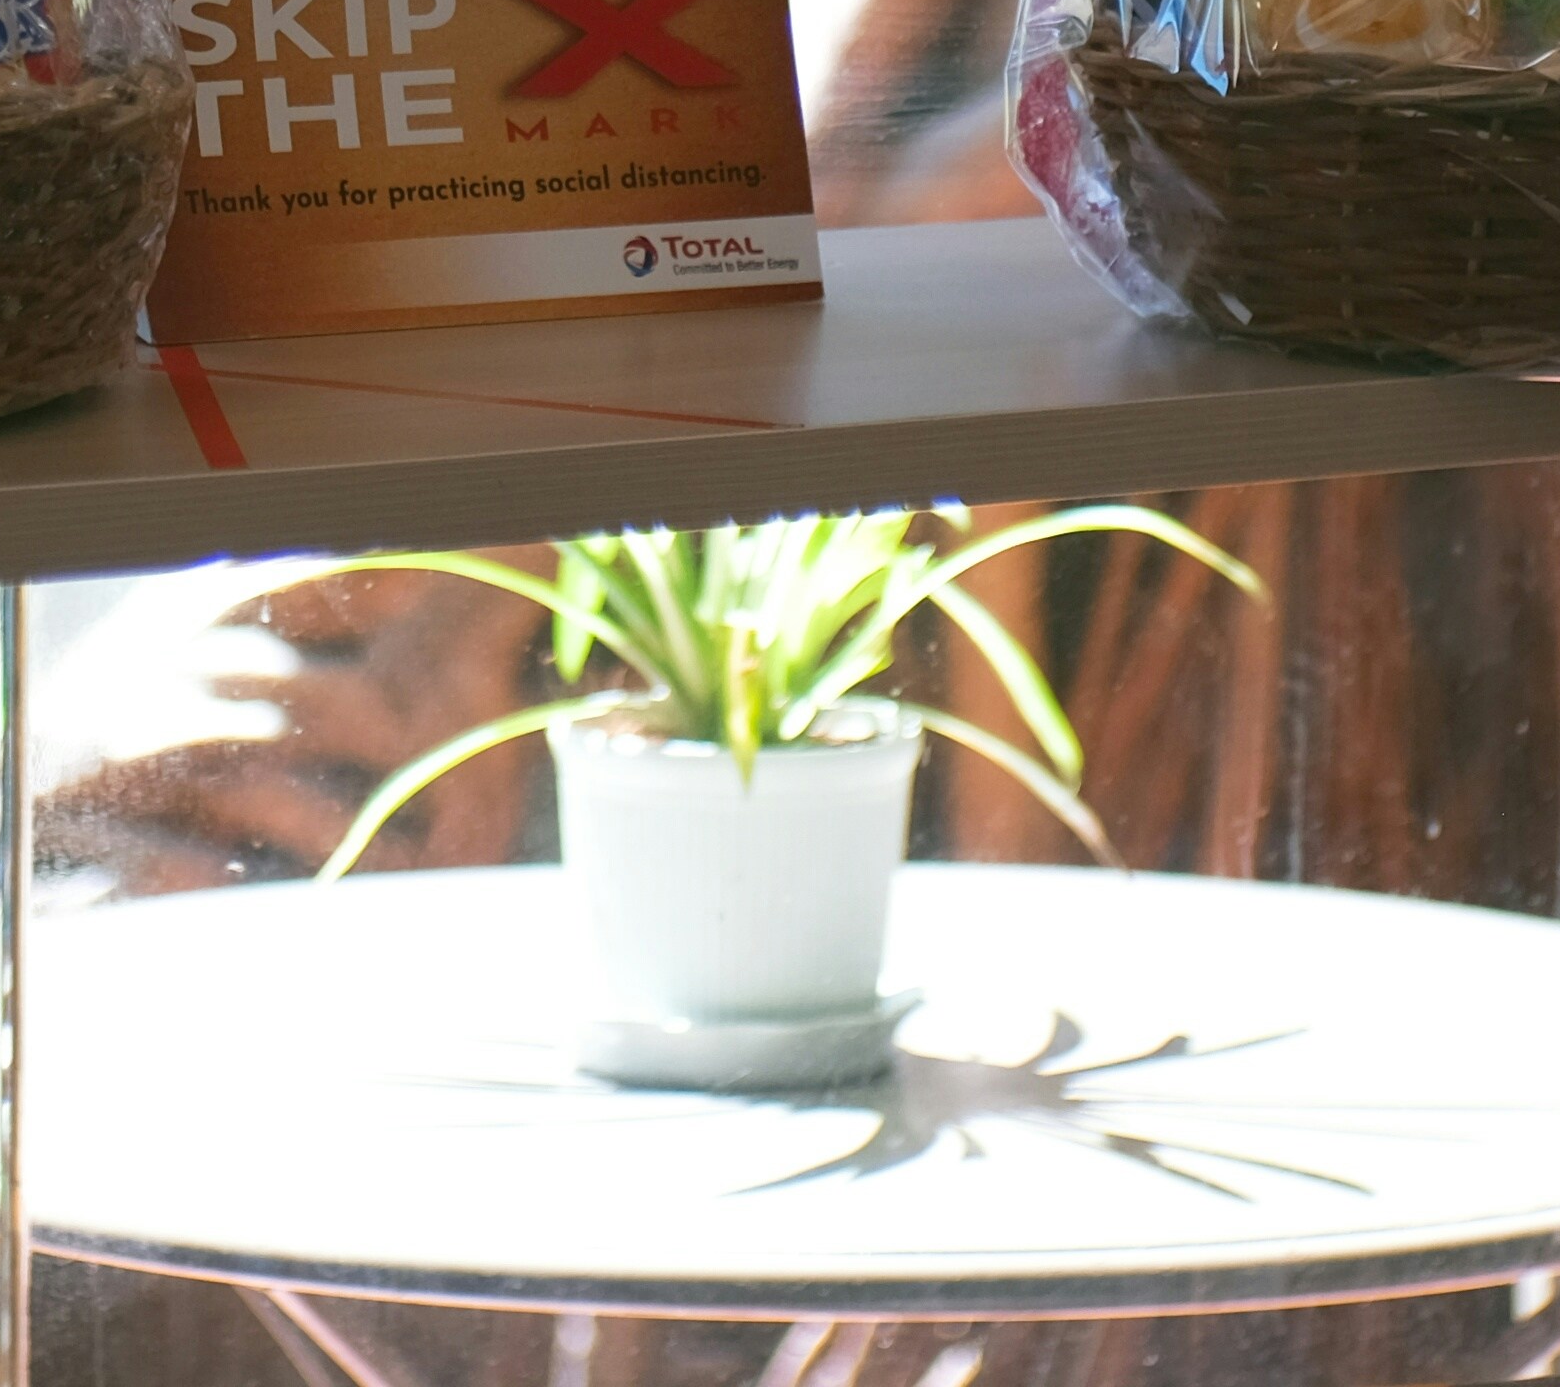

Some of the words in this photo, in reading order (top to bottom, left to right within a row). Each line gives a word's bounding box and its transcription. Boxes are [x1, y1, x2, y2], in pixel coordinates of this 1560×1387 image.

[195, 69, 464, 157] THE
[505, 106, 741, 143] MARK
[185, 188, 272, 215] Thank
[281, 191, 329, 214] you
[340, 180, 377, 208] for
[388, 175, 526, 209] practicing
[536, 165, 611, 195] social
[620, 160, 768, 189] distancing.
[661, 236, 764, 259] TOTAL
[725, 261, 735, 271] to
